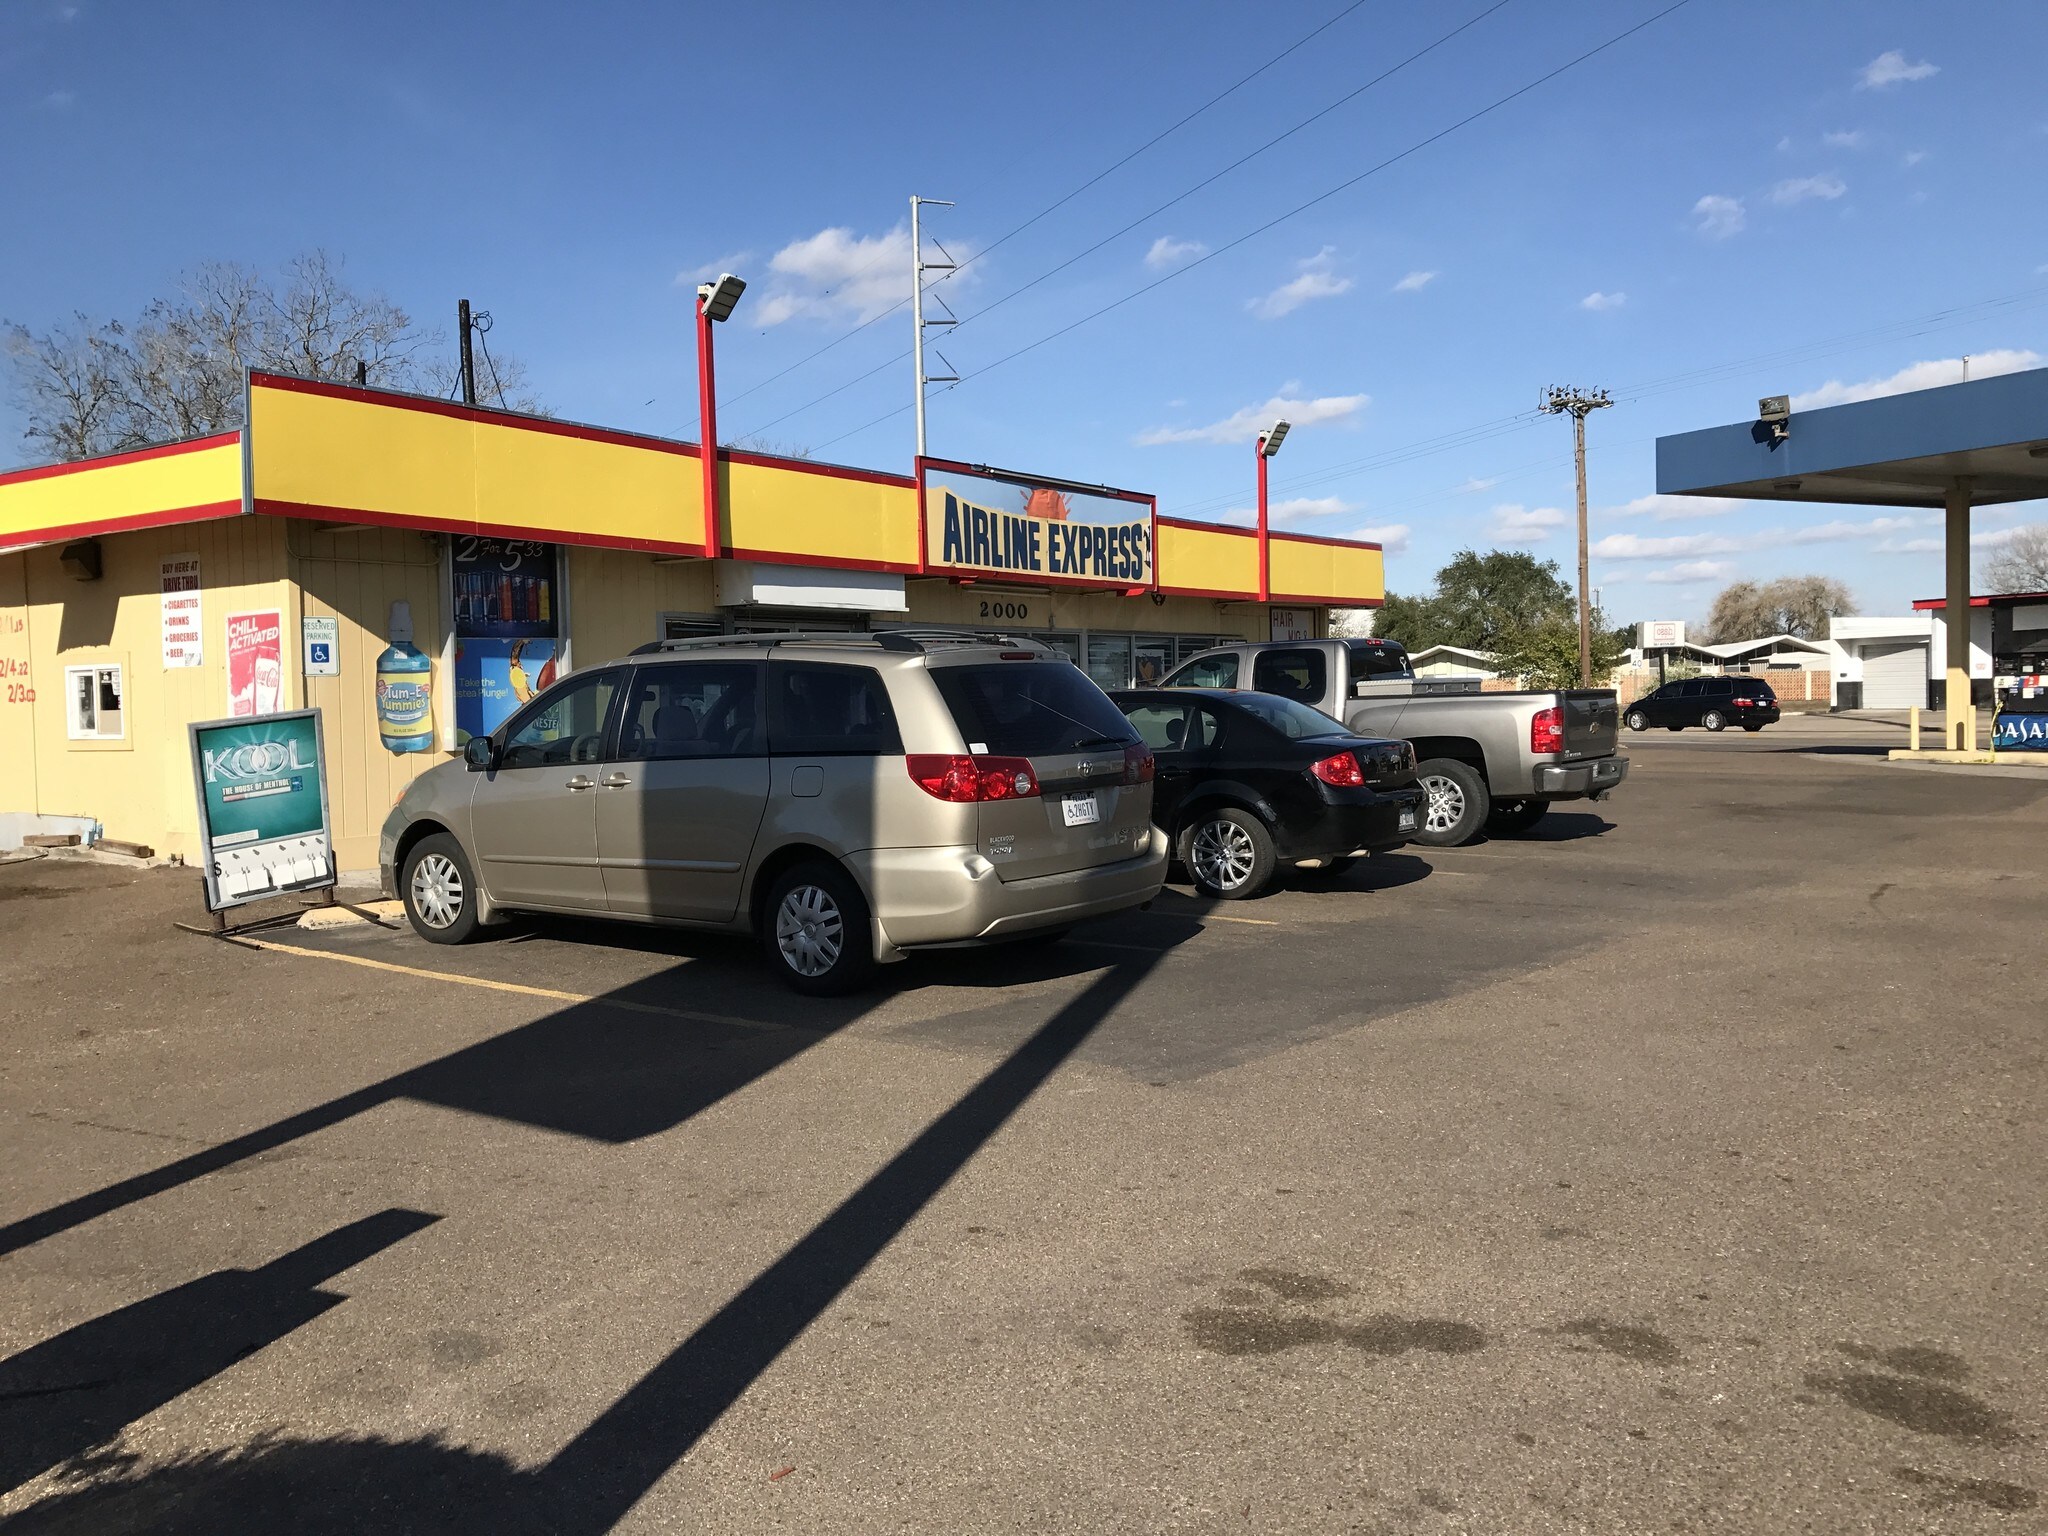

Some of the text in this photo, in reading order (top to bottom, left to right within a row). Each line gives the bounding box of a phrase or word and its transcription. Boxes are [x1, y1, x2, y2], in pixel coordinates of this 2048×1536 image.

[943, 492, 1143, 580] AIRLINE EXPRESS
[162, 560, 198, 574] BUY HERE AT
[163, 574, 199, 592] DRIVE THRU
[168, 598, 199, 610] CIGARETTES
[979, 601, 1028, 619] 2000
[168, 616, 190, 627] DRINKS
[228, 616, 259, 638] CHILL
[304, 621, 335, 631] RESERVED
[1273, 611, 1294, 627] HAIR
[169, 632, 199, 643] GROCERIES
[229, 626, 279, 651] ACTIVATED
[306, 632, 333, 641] PARKING
[170, 649, 184, 659] BEER
[1632, 659, 1643, 668] 40
[459, 678, 496, 688] Take the
[386, 684, 423, 700] Tum-E
[478, 688, 508, 700] Plunge!
[380, 695, 426, 712] Yummies
[1992, 717, 2048, 743] DASA
[203, 738, 317, 784] KOOL
[222, 778, 290, 796] THE HOUSE OF MENTHOL
[213, 861, 222, 877] $
